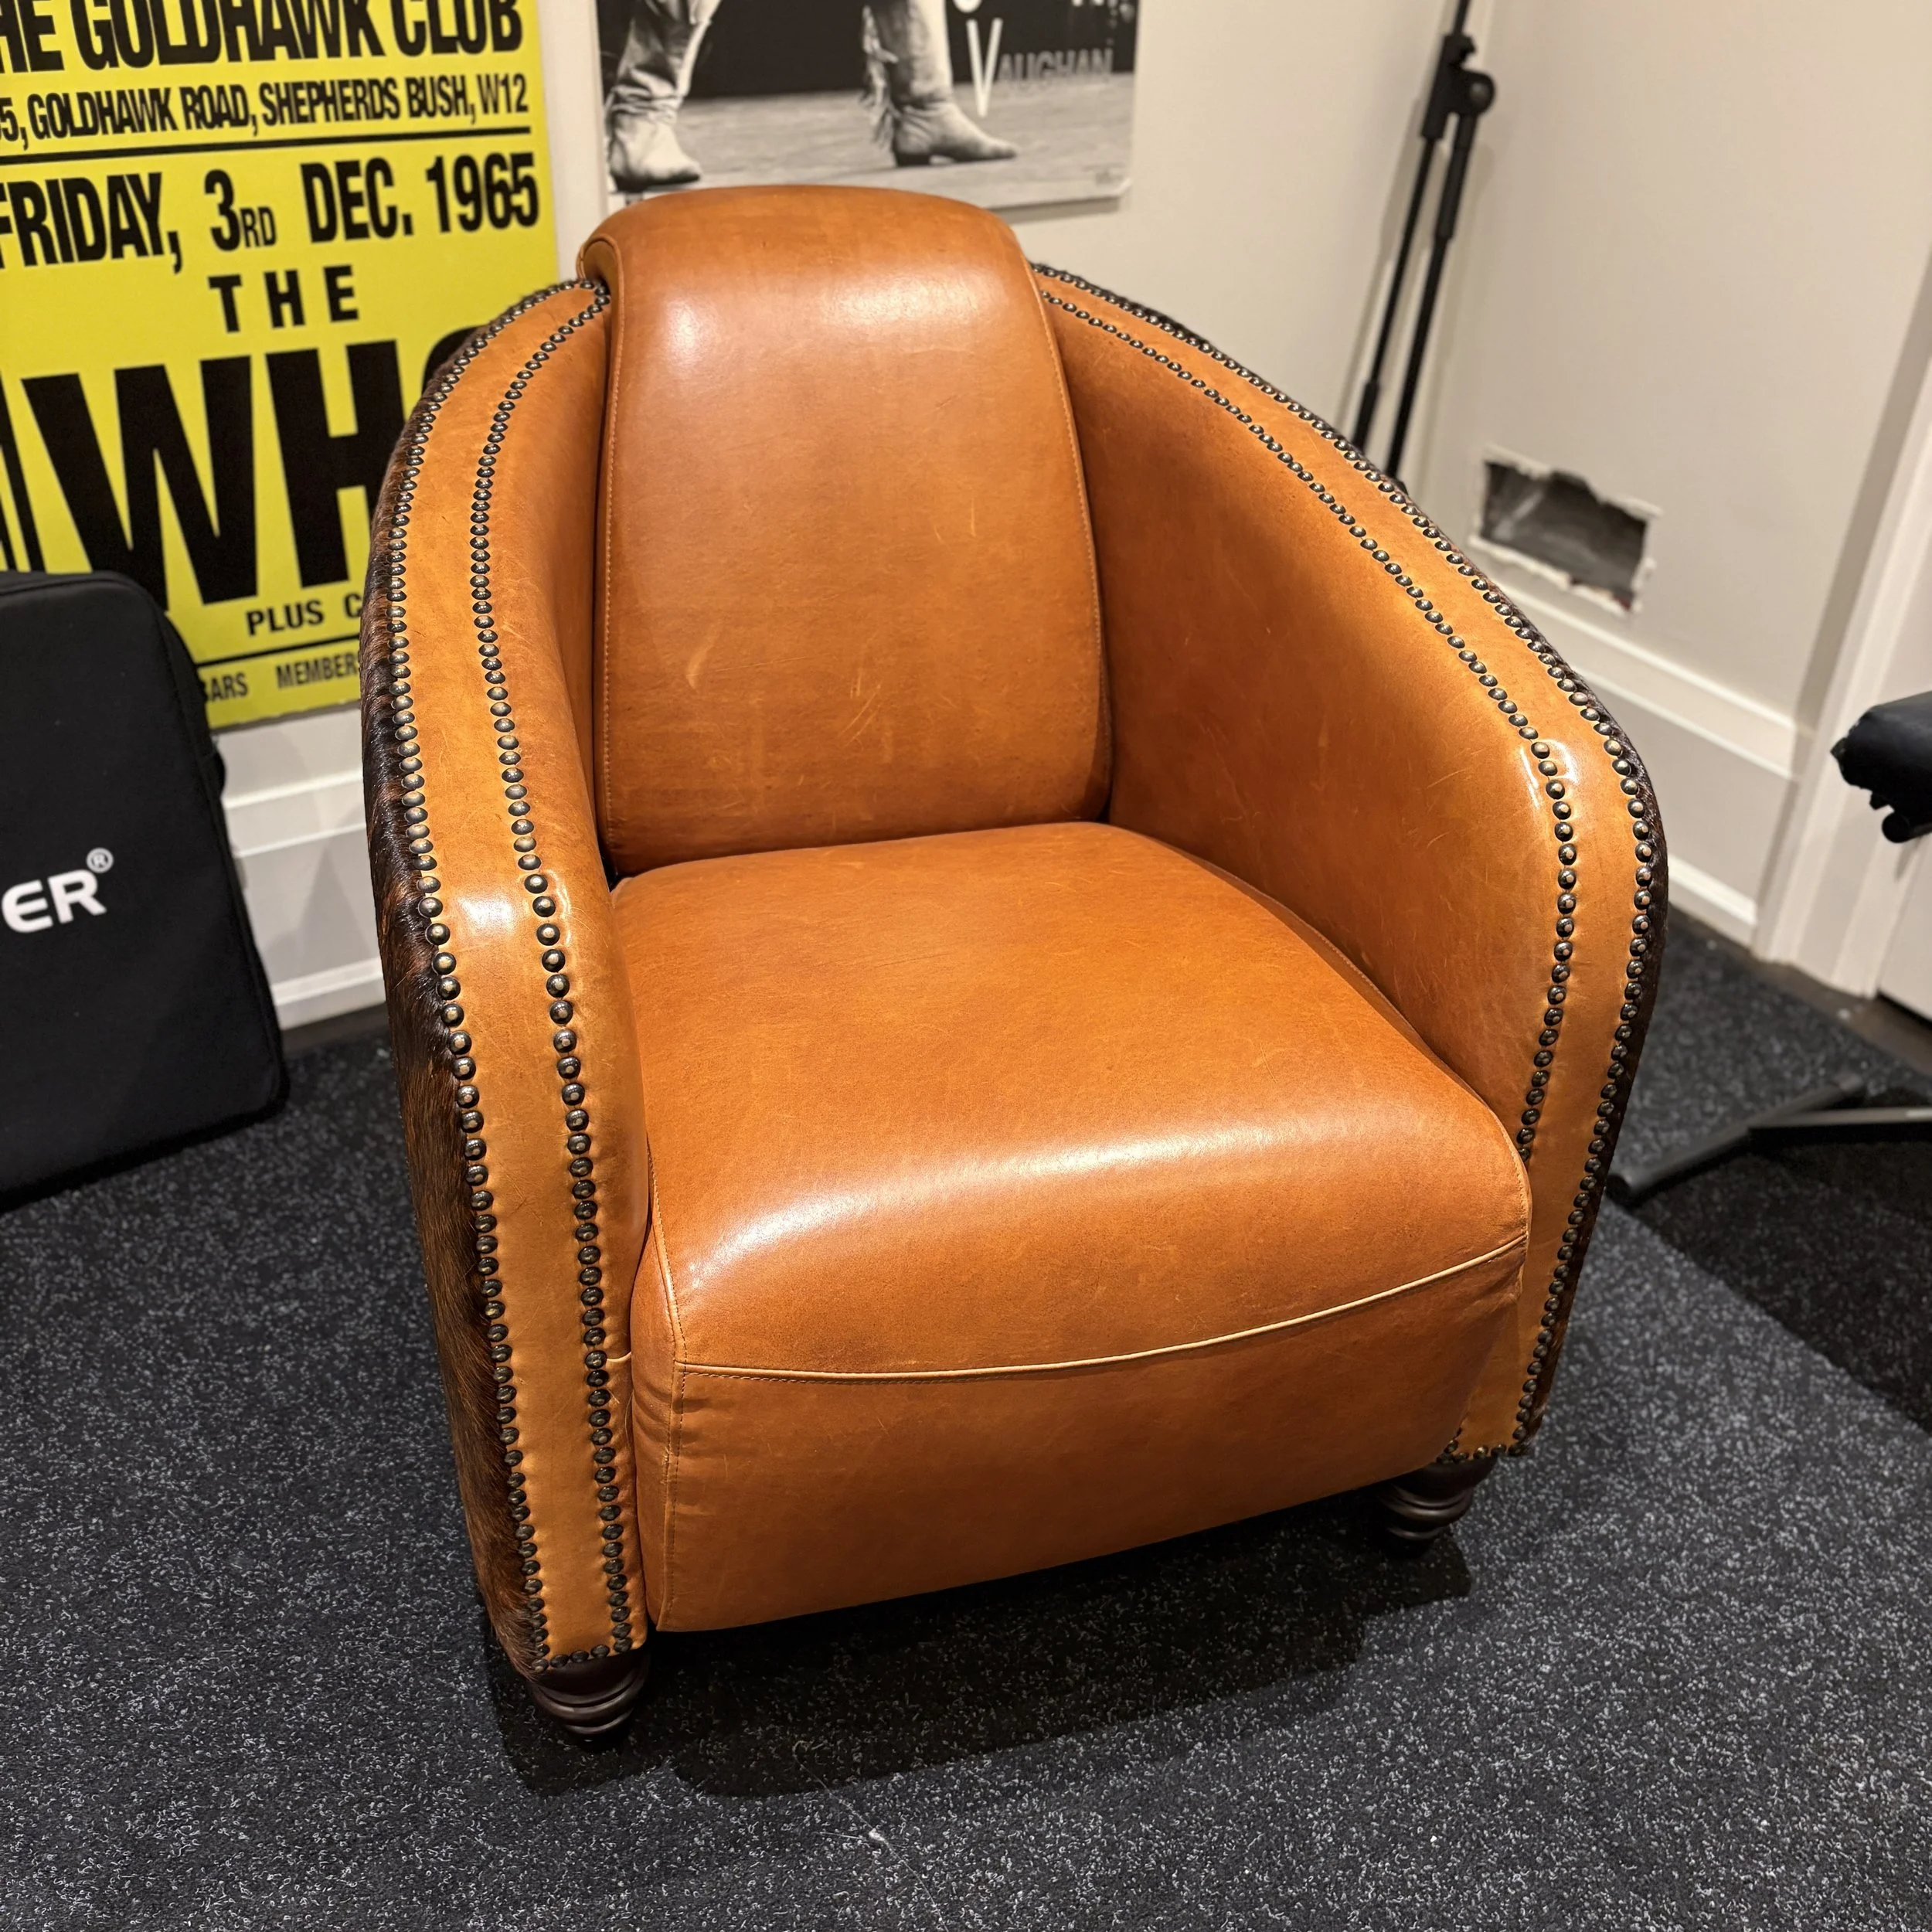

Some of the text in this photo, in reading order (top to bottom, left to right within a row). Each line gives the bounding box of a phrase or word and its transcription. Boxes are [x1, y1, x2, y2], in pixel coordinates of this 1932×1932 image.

[70, 0, 386, 70] GOLDHAWK
[389, 0, 523, 57] CLUB
[967, 18, 1113, 117] VAUGHAN
[27, 87, 179, 140] GOLDHAWK
[179, 83, 258, 136] ROAD,
[259, 77, 400, 126] SHEPHERDS
[405, 74, 476, 124] BUSH,
[476, 73, 529, 114] W12
[204, 169, 277, 250] 3RD
[300, 157, 414, 243] DEC.
[426, 151, 539, 233] 1965
[208, 265, 359, 333] THE
[246, 599, 324, 636] PLUS
[204, 652, 360, 701] ARS MEMBER
